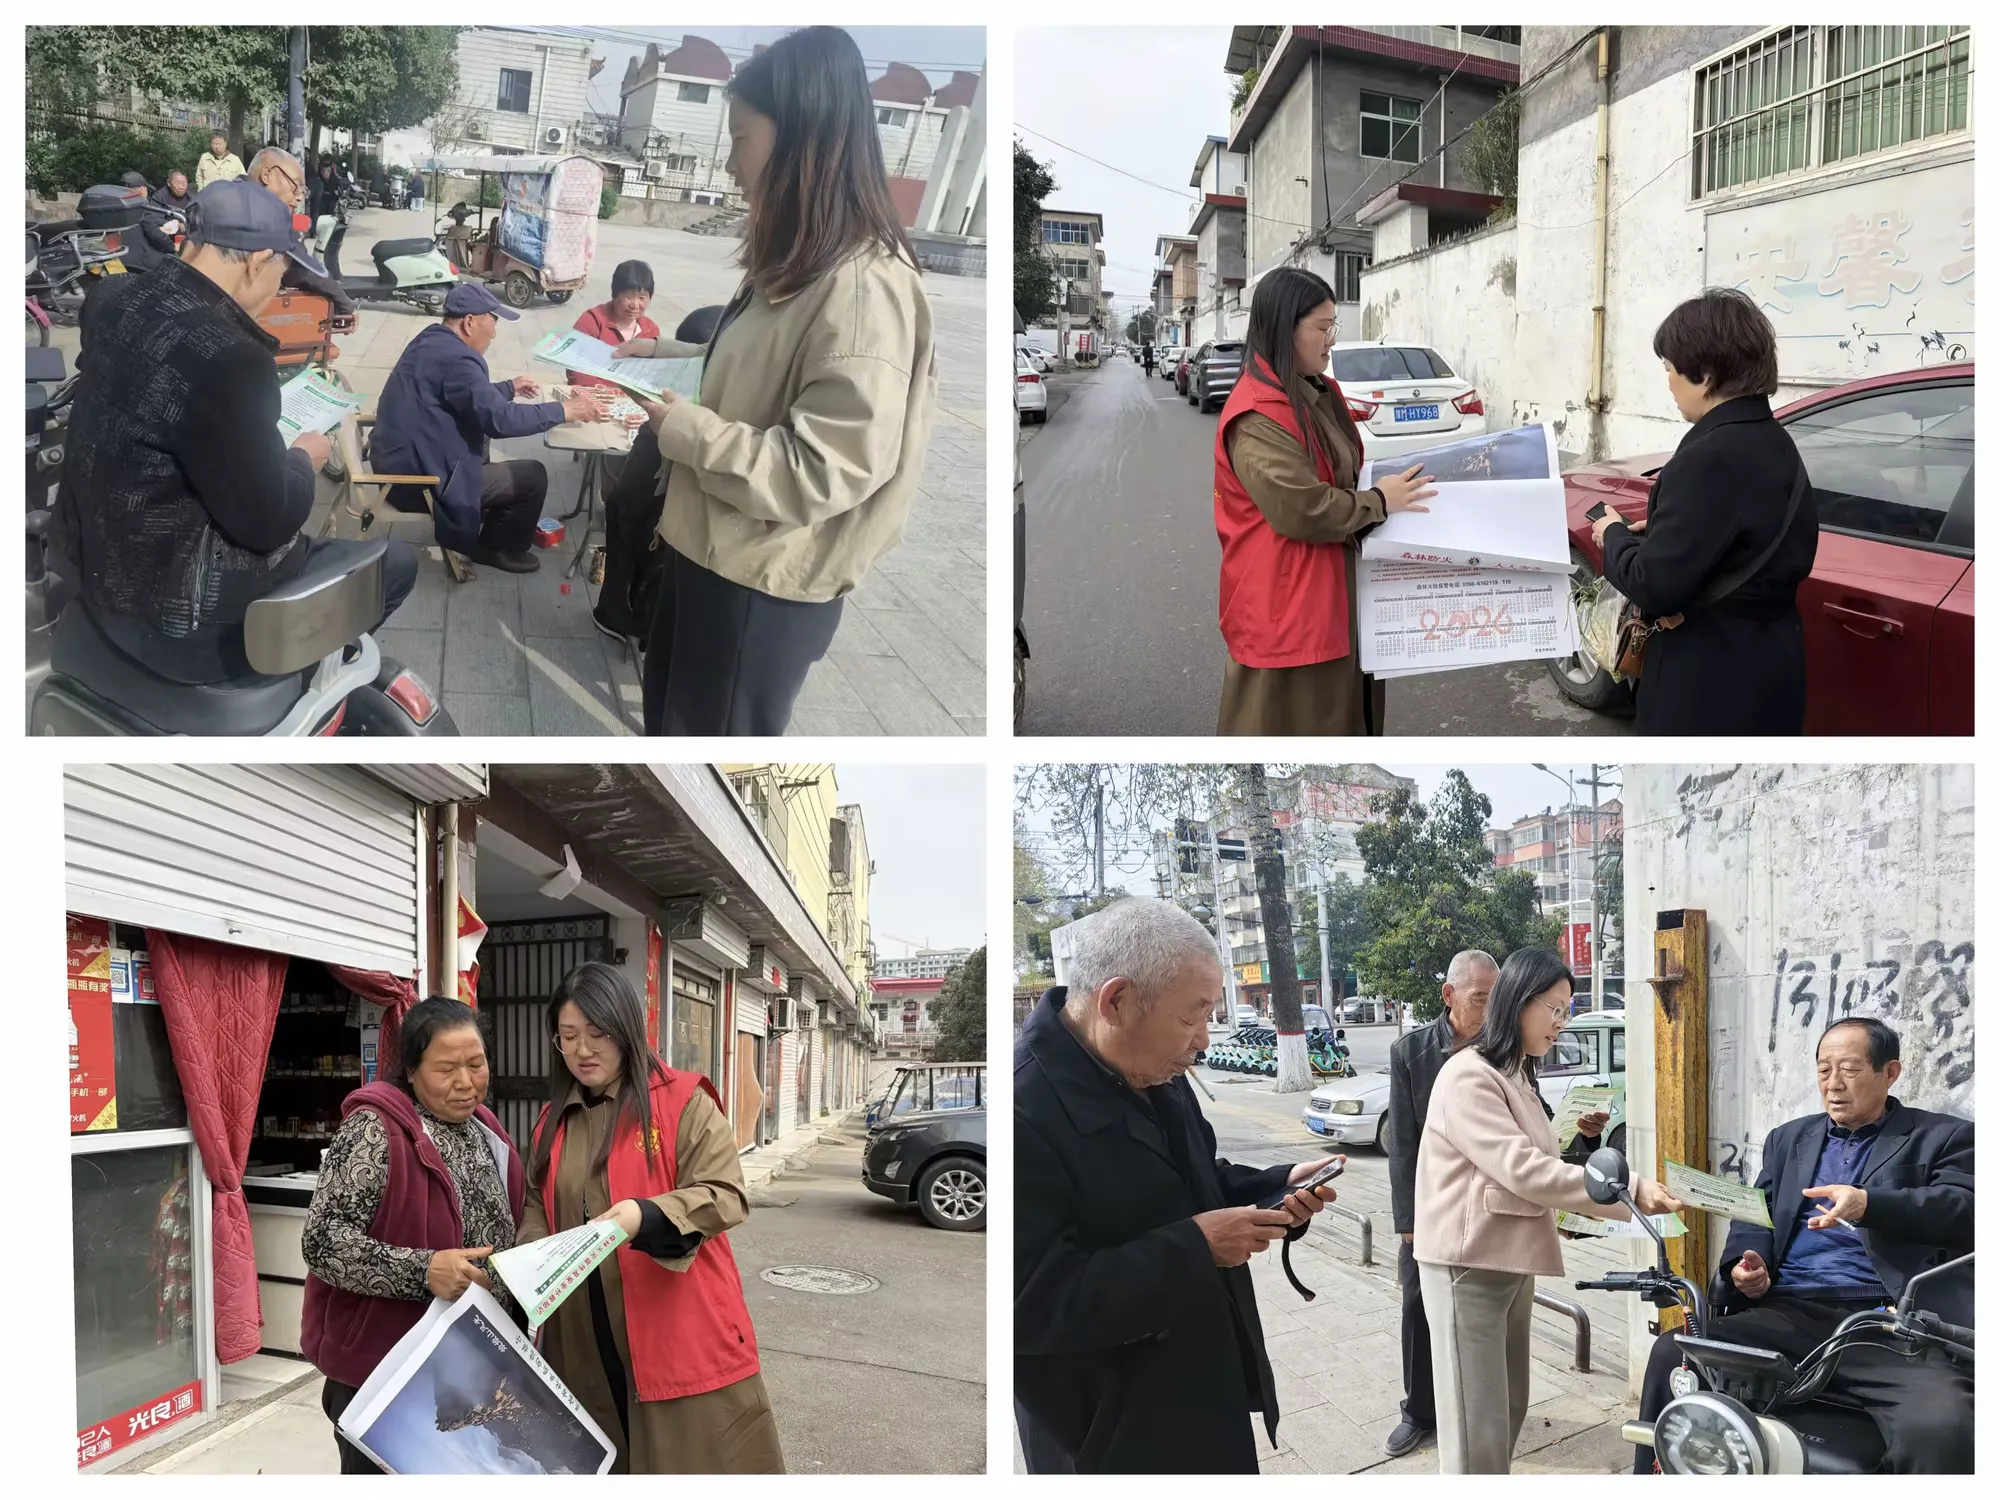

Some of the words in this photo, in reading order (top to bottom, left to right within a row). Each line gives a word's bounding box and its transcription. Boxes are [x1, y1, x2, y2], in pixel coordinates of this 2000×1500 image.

[1418, 603, 1513, 641] 2026
[70, 1087, 109, 1097] 手机一部
[70, 1113, 87, 1122] 火机
